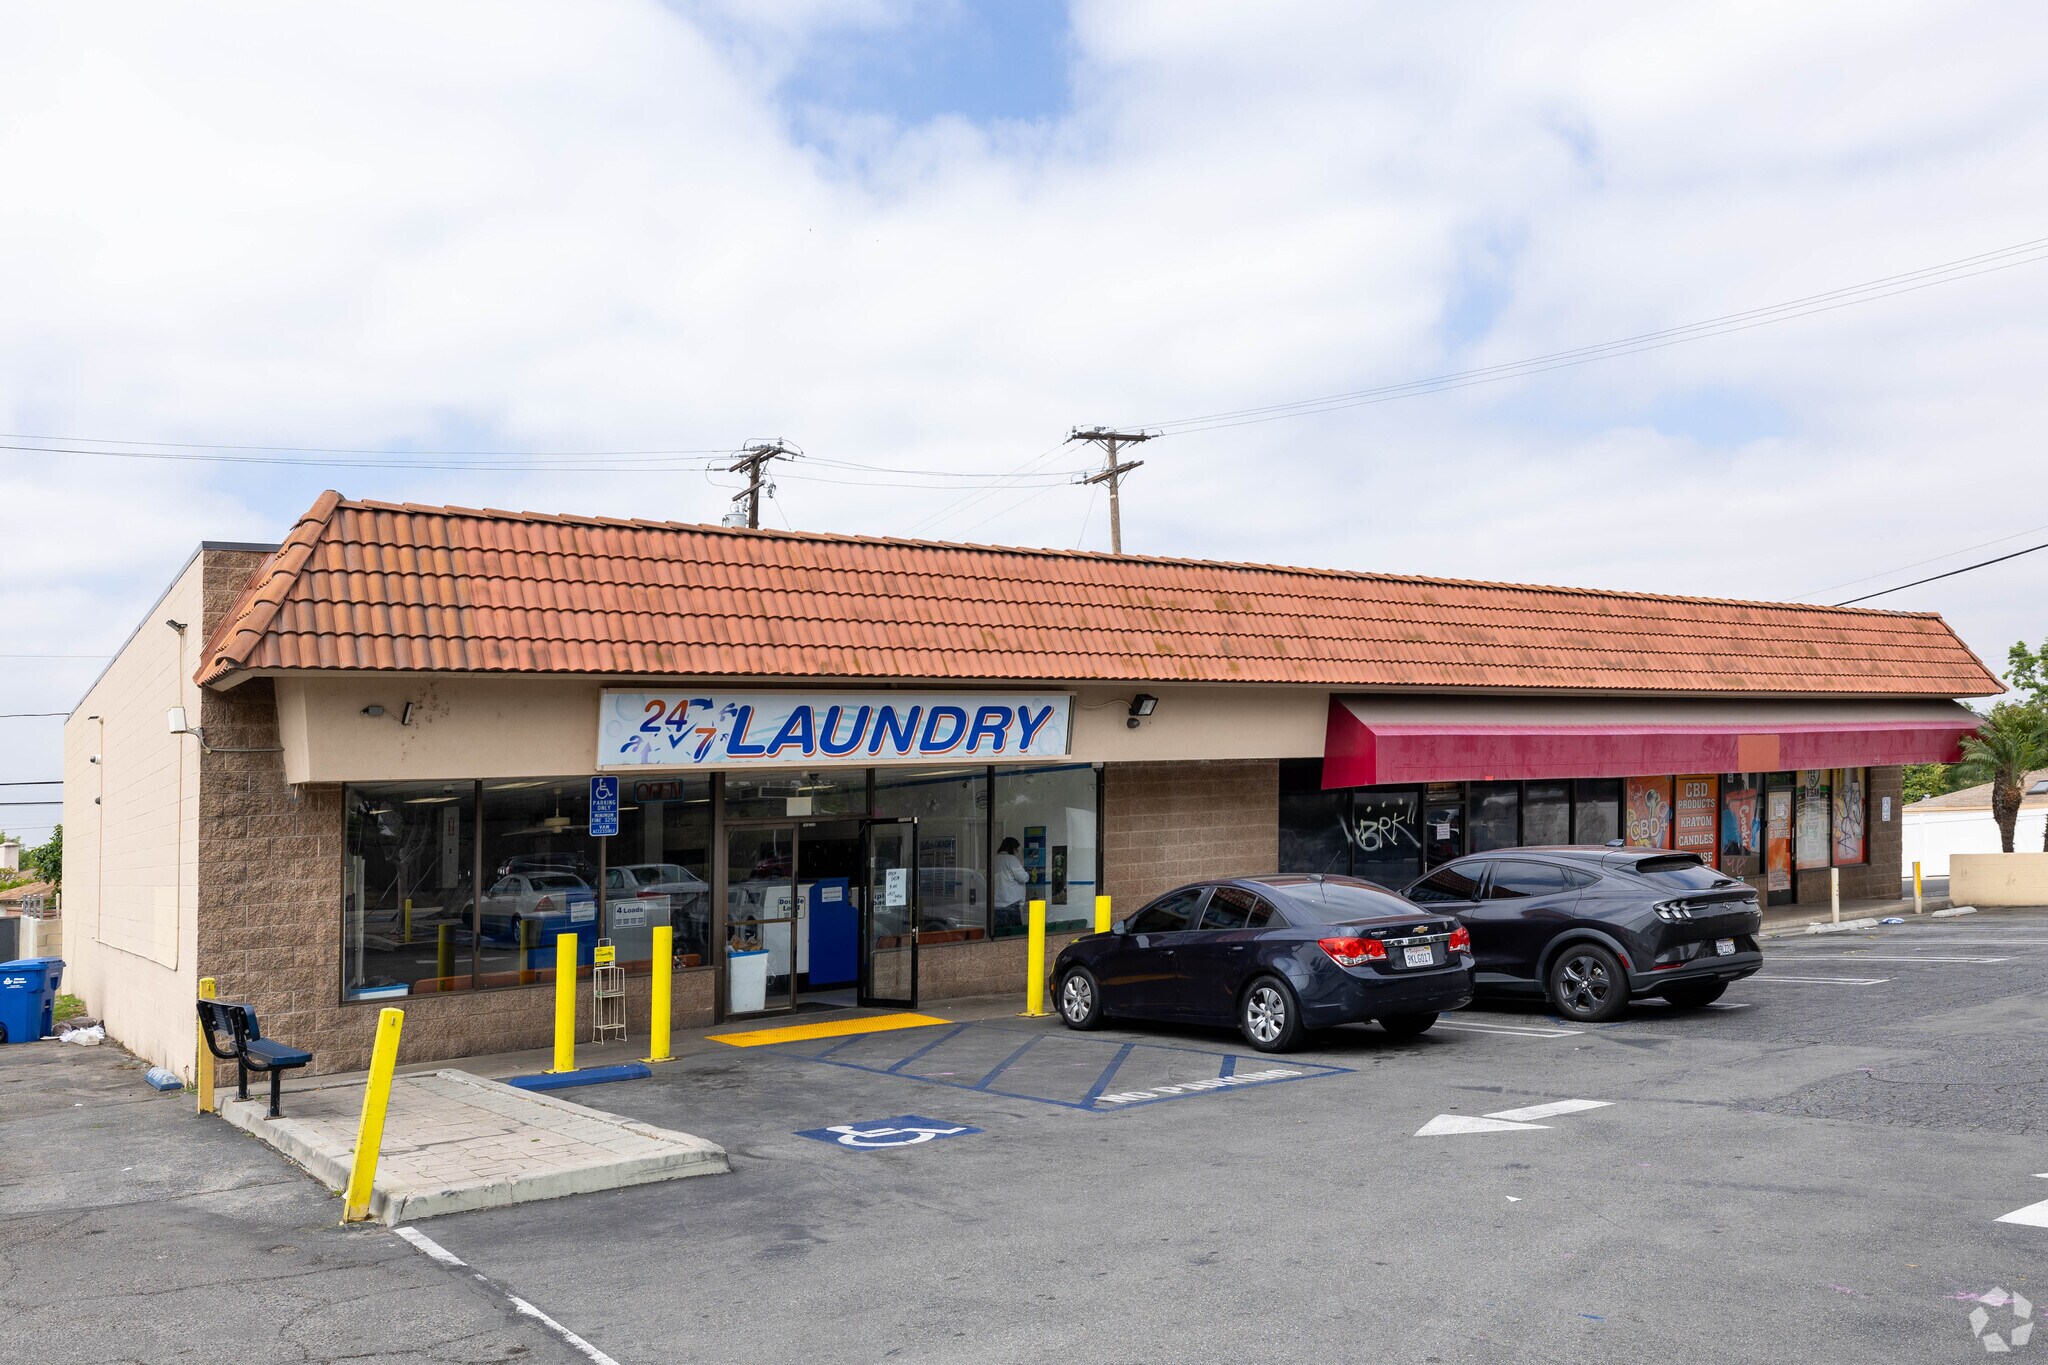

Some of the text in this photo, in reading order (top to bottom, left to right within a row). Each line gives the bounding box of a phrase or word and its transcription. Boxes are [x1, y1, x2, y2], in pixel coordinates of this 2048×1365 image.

[639, 699, 1055, 760] 24 7 LAUNDRY
[637, 783, 682, 799] OPEN
[1685, 782, 1708, 798] CBD
[1678, 799, 1715, 810] PRODUCTS
[1680, 816, 1713, 828] KRATOM
[1678, 834, 1714, 847] CANDLES
[623, 906, 643, 914] Loads
